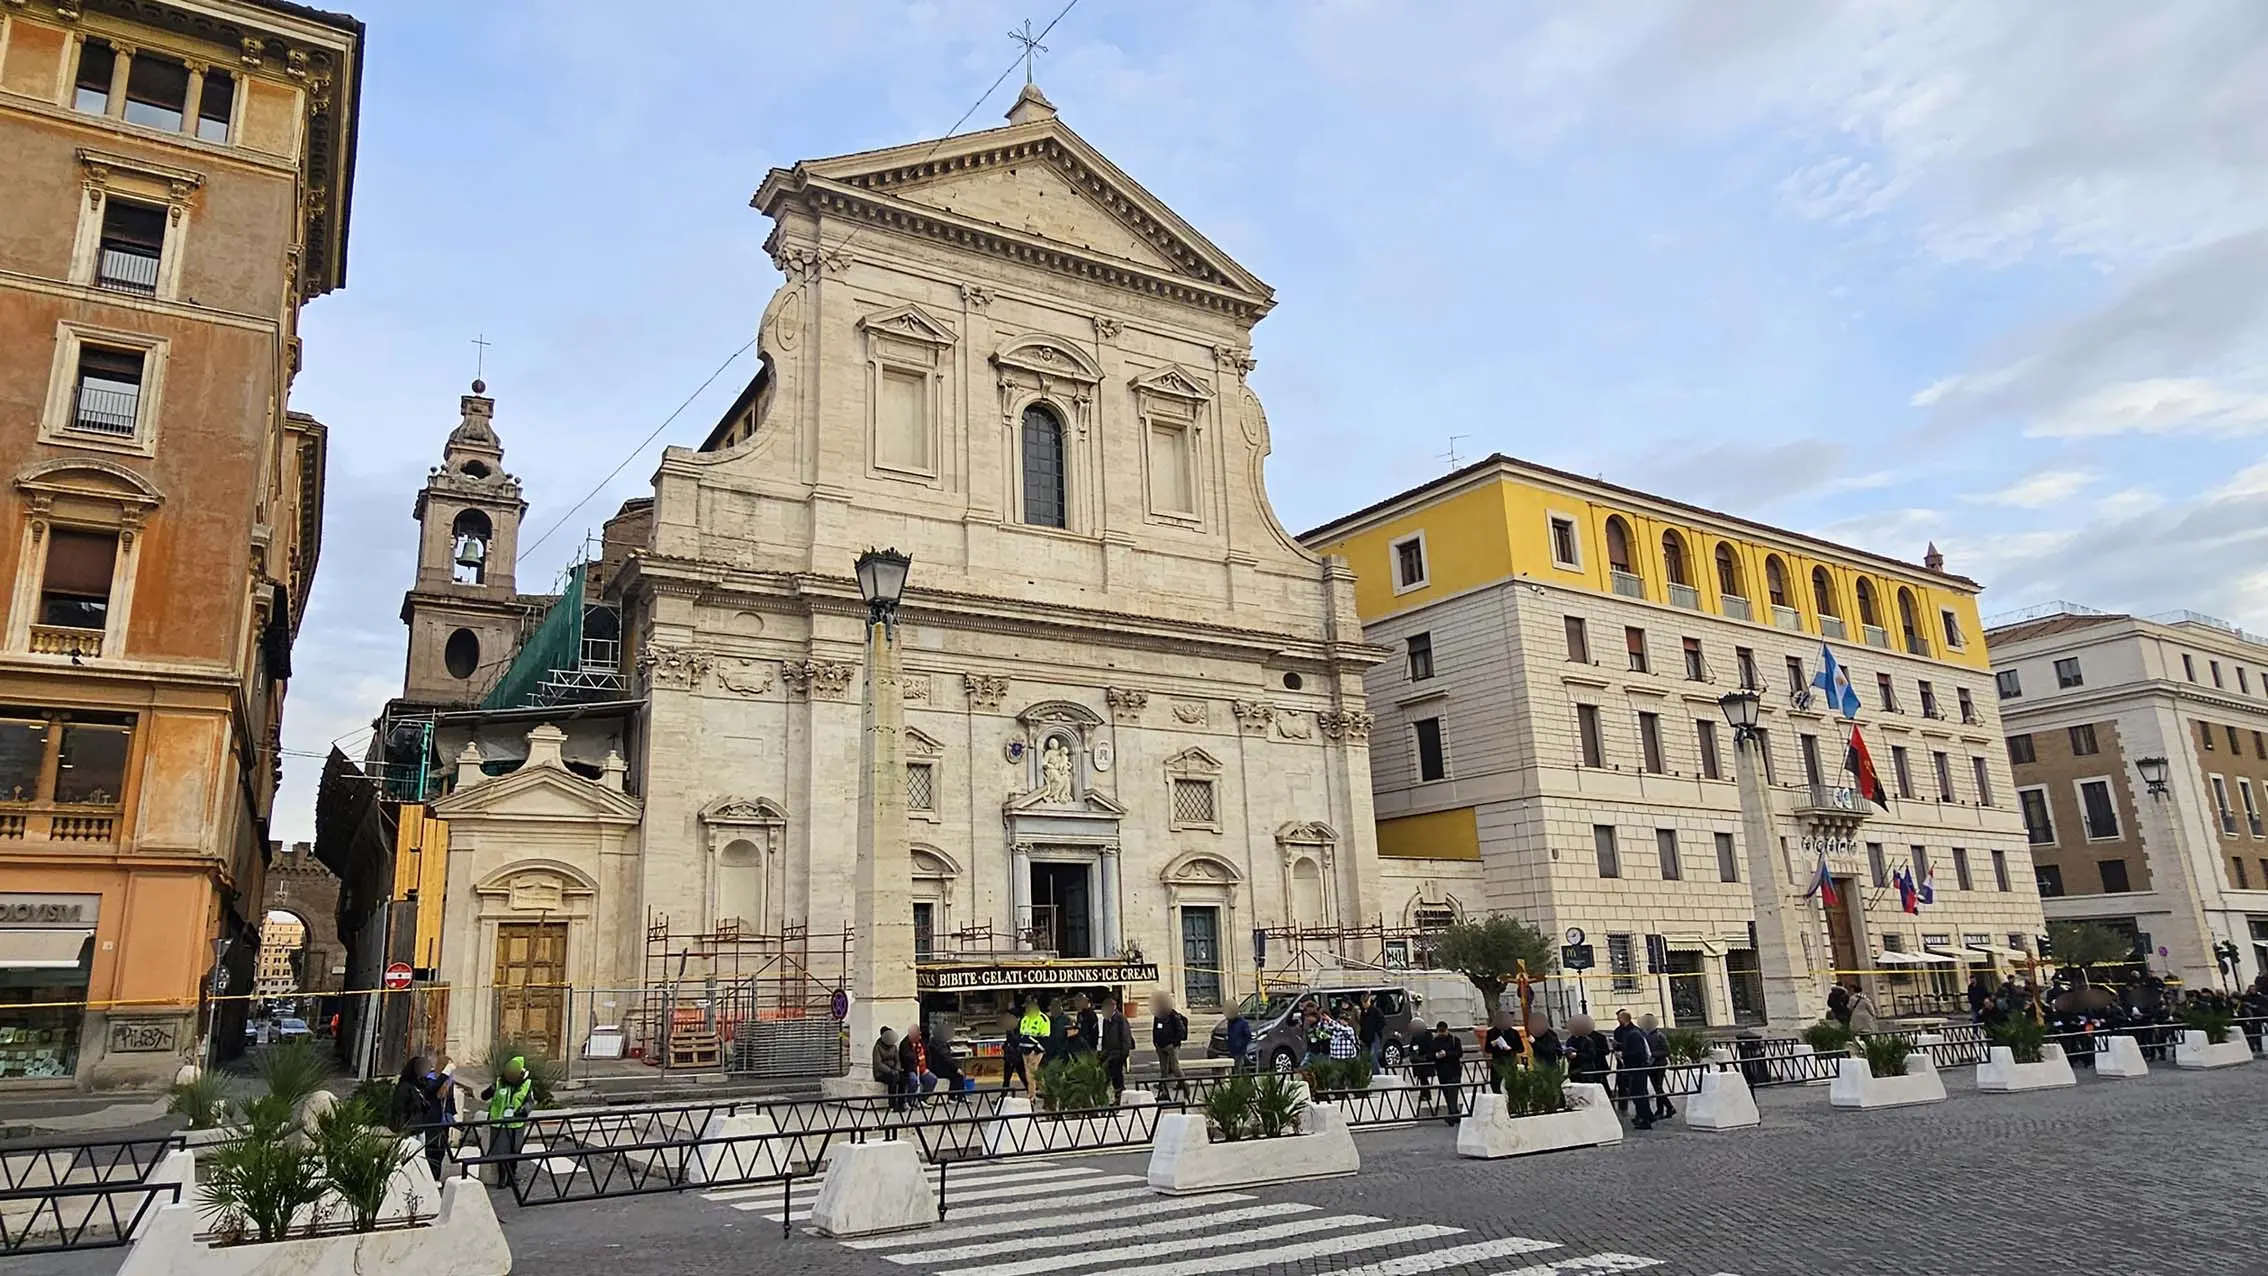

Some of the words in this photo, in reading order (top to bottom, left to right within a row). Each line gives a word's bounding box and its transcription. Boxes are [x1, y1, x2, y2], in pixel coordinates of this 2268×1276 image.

[939, 972, 978, 987] BIBITE
[982, 970, 1023, 984] GELATI
[1028, 968, 1057, 983] COLD
[1059, 968, 1098, 982] DRINKS
[1102, 967, 1119, 981] ICE
[1121, 967, 1157, 980] CREAM
